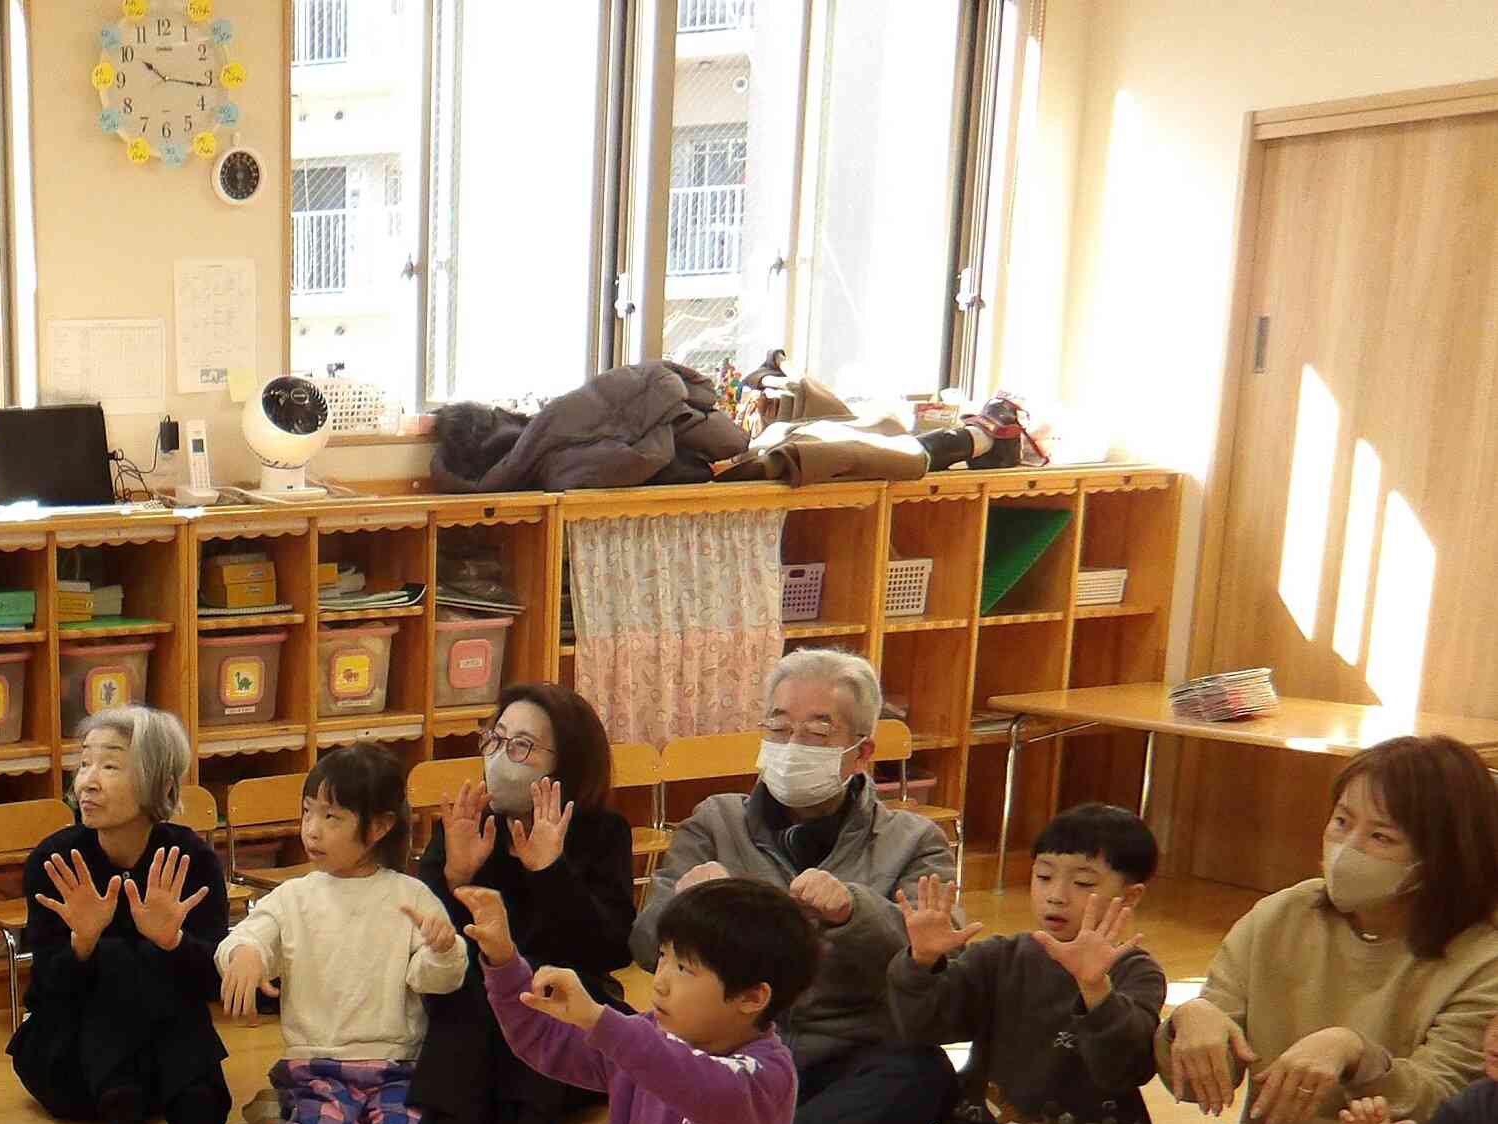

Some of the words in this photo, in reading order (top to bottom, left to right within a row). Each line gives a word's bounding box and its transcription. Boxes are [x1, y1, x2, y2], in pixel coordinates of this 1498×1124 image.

[135, 25, 146, 44] 11
[156, 18, 171, 36] 12
[182, 25, 189, 42] 1
[119, 46, 134, 63] 10
[197, 44, 207, 61] 2
[116, 71, 126, 88] 9
[204, 70, 213, 87] 3
[122, 97, 133, 114] 8
[196, 95, 206, 111] 4
[139, 116, 150, 133] 7
[161, 121, 172, 138] 6
[183, 115, 193, 132] 5
